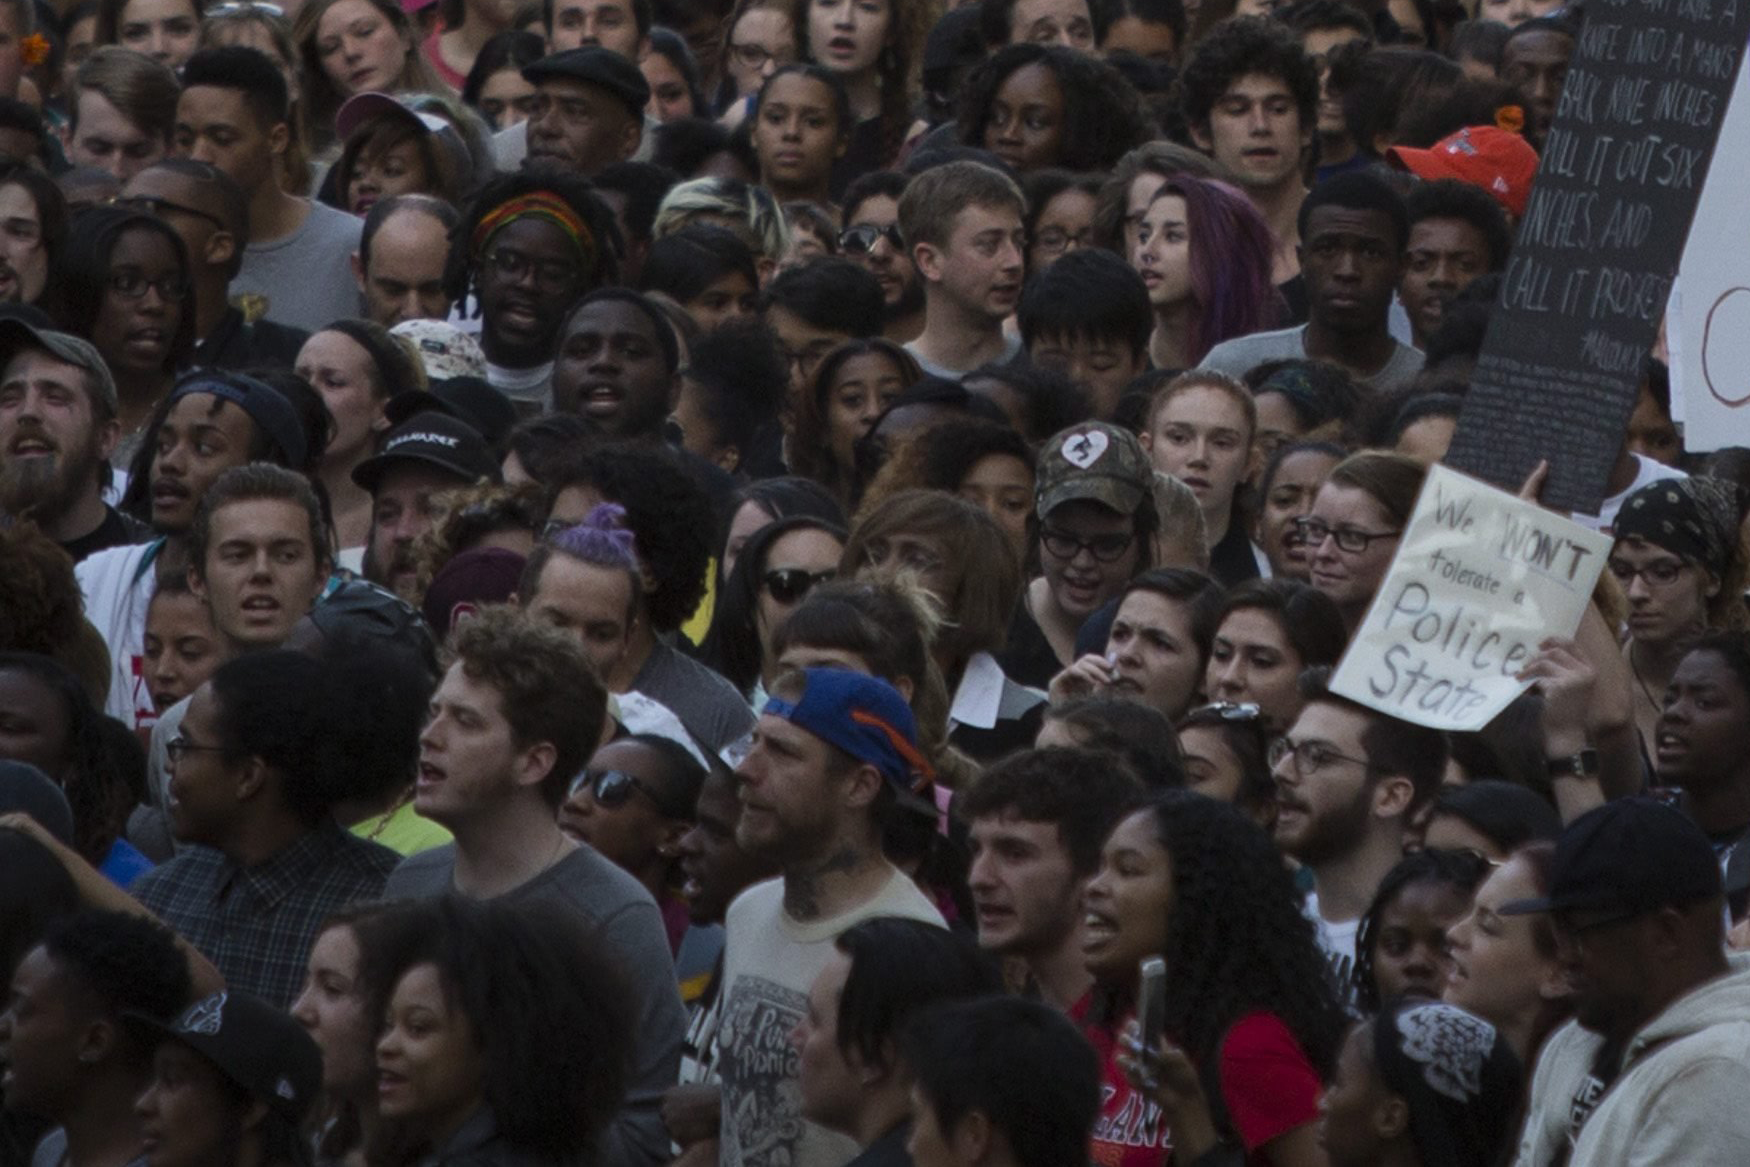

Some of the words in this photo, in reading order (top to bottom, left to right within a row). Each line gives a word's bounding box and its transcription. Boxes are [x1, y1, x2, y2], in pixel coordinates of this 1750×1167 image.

[1652, 80, 1718, 127] INCHES
[1587, 134, 1614, 187] IT
[1614, 134, 1663, 186] OUT
[1662, 142, 1703, 191] SIX
[1601, 198, 1652, 248] AND
[1502, 254, 1552, 313] CALL
[1559, 269, 1589, 317] IT
[1432, 482, 1475, 531] We
[1500, 512, 1593, 583] WON'T
[1429, 548, 1503, 597] tolerate
[1384, 582, 1528, 678] Police
[1369, 644, 1489, 724] State
